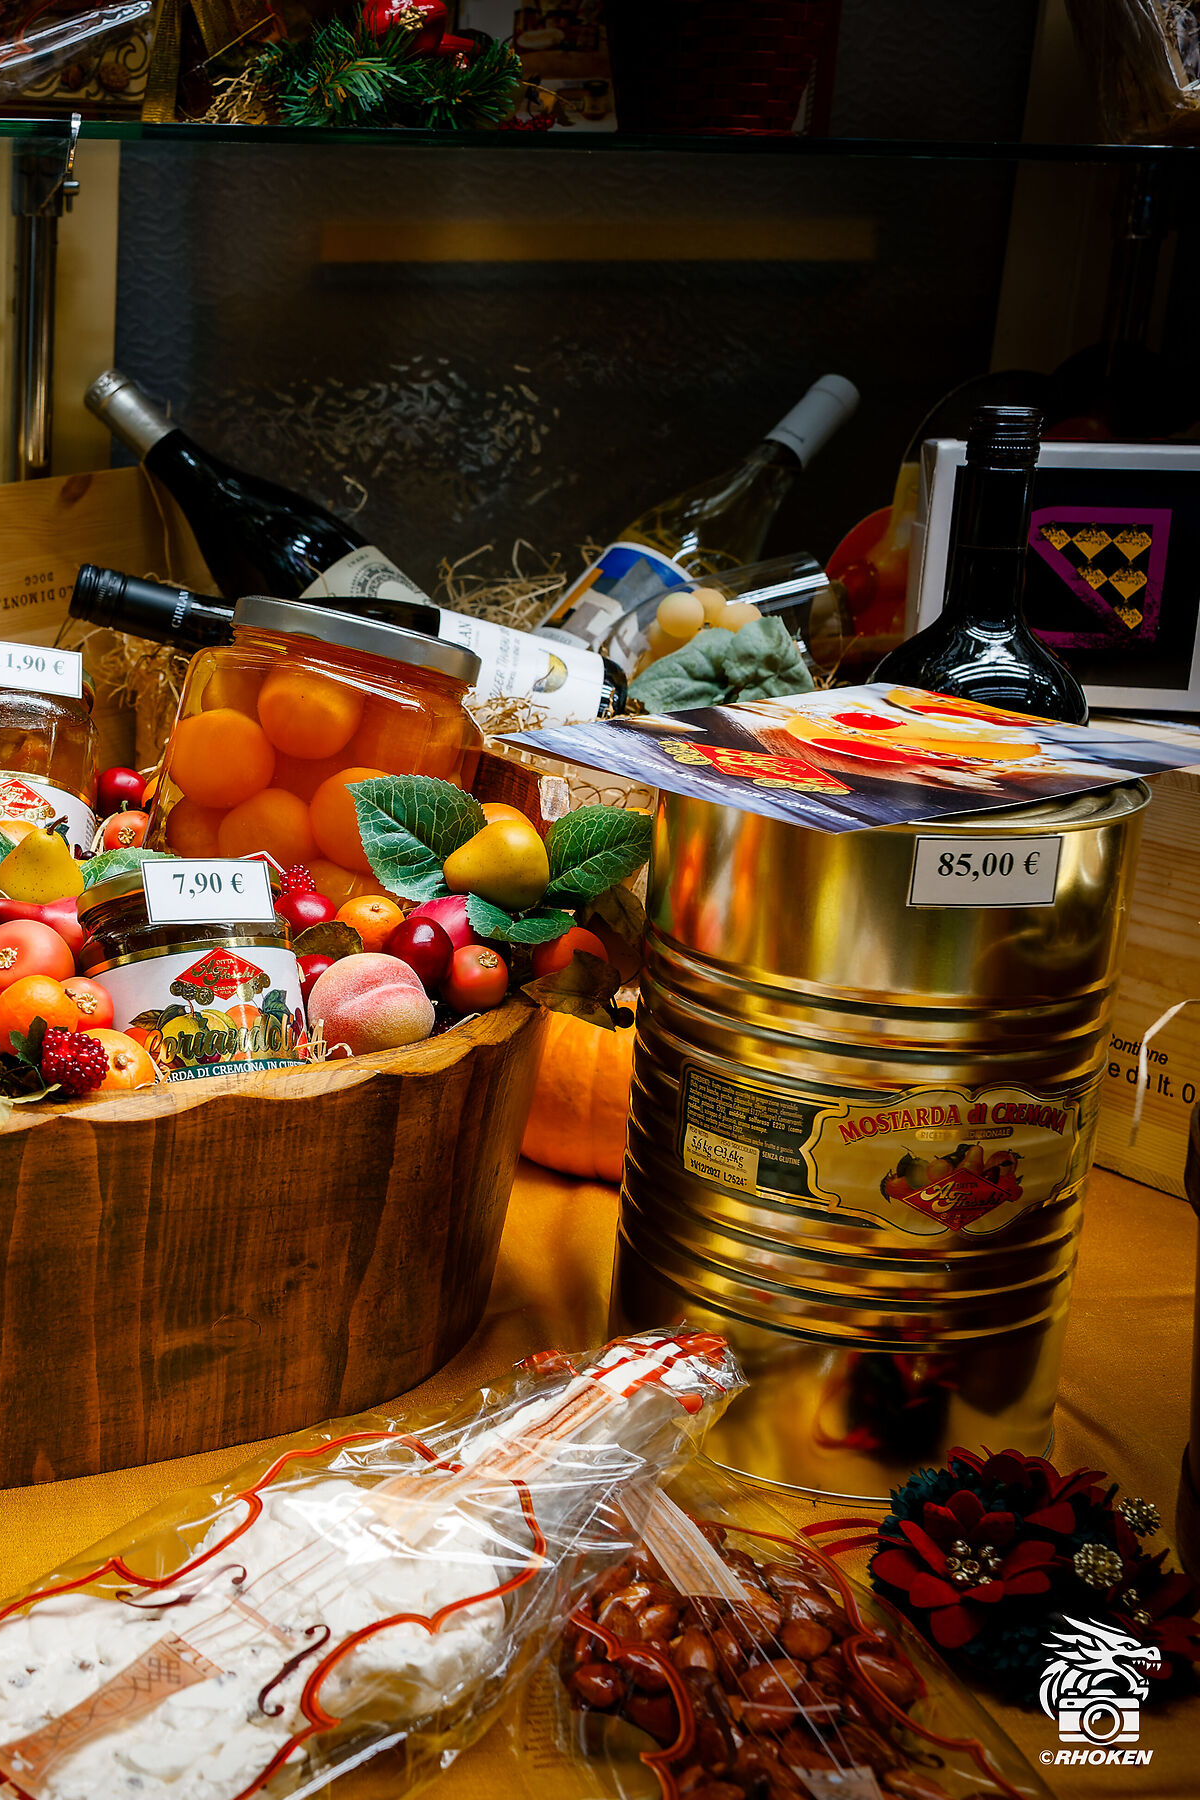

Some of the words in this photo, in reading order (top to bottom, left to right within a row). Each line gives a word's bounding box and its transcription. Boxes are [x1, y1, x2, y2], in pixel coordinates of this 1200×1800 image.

[24, 572, 54, 586] DOCG
[41, 588, 56, 601] DI
[458, 620, 472, 648] LAN
[53, 660, 65, 675] €
[937, 852, 1014, 882] 85,00
[1023, 851, 1041, 875] €
[171, 872, 223, 899] 7,90
[230, 872, 245, 894] €
[215, 958, 235, 966] DITTA
[147, 1012, 300, 1067] Coriandoli
[197, 1067, 210, 1078] DI
[212, 1061, 265, 1076] CREMONA
[267, 1060, 279, 1070] IN
[772, 1120, 785, 1131] E220
[837, 1104, 962, 1146] MOSTARDA
[967, 1102, 988, 1125] di
[991, 1102, 1069, 1136] CREMONA
[762, 1150, 779, 1161] SENZA
[778, 1155, 801, 1166] GLUTINE
